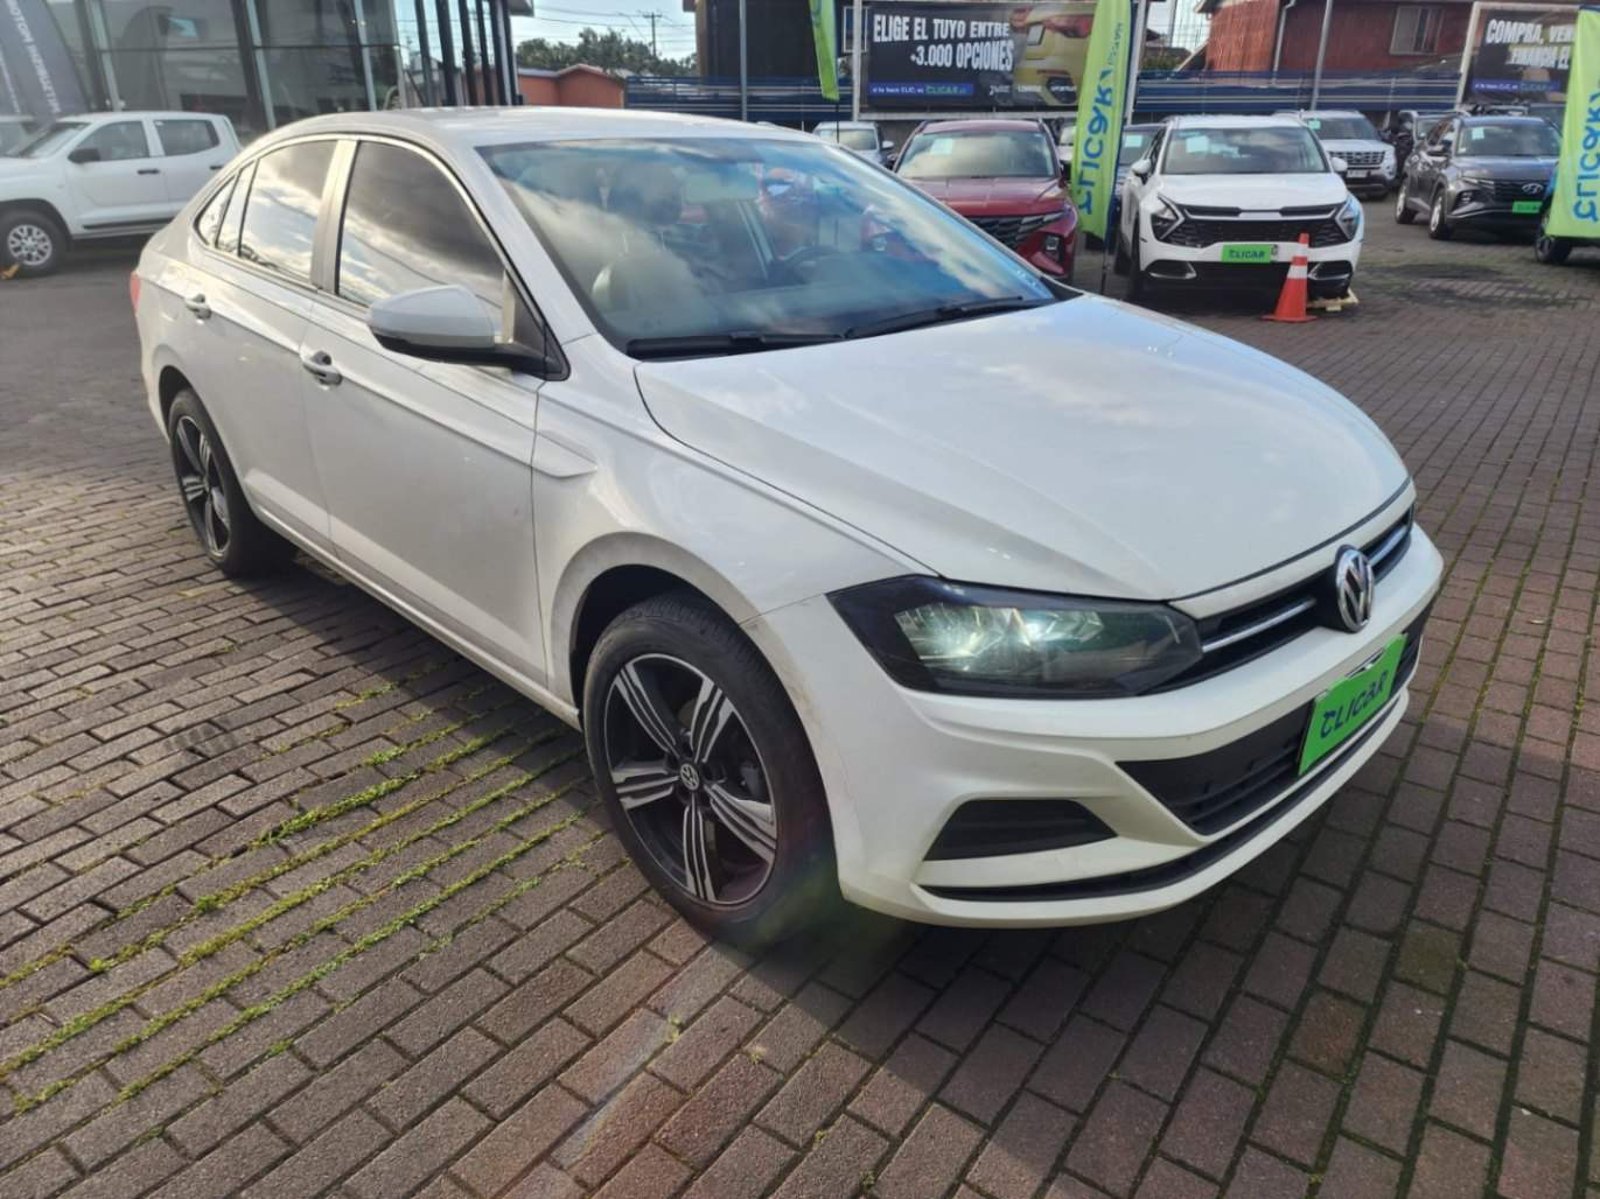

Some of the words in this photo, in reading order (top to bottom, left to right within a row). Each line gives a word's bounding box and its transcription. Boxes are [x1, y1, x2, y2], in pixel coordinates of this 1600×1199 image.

[873, 14, 910, 42] ELIGE
[914, 17, 929, 40] EL
[932, 19, 966, 40] TUYO
[969, 21, 1010, 38] ENTRE
[1485, 19, 1544, 44] COMPRA,
[955, 40, 1014, 71] OPCIONES
[1320, 669, 1388, 739] CLICAR
